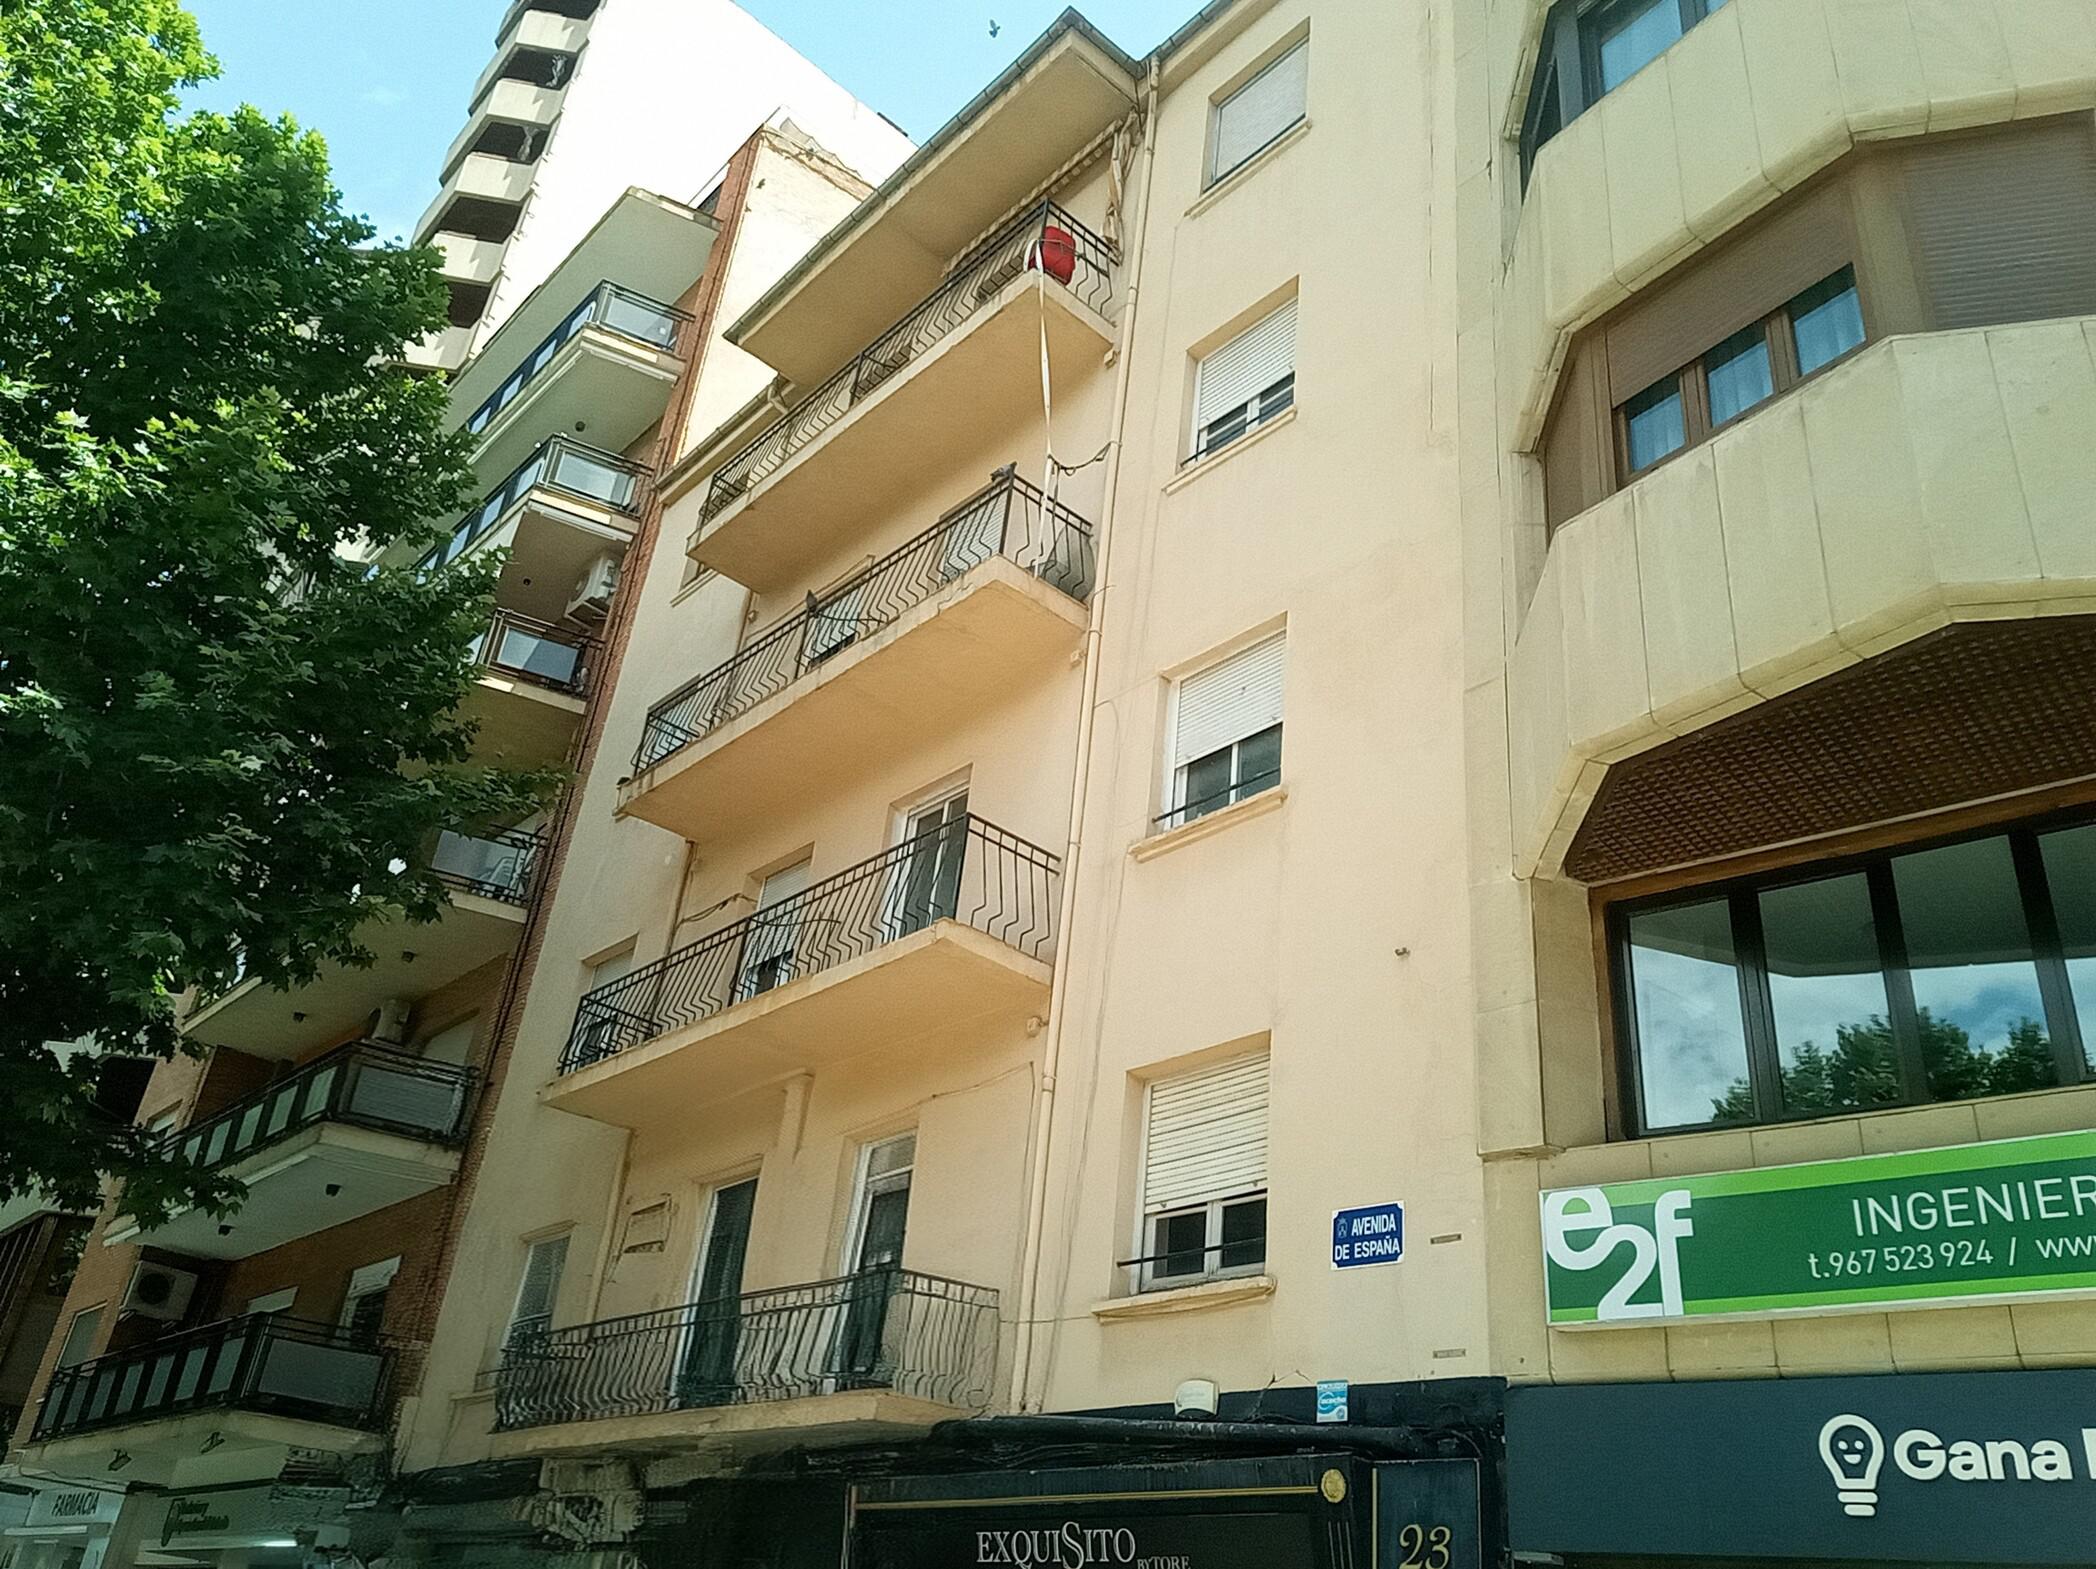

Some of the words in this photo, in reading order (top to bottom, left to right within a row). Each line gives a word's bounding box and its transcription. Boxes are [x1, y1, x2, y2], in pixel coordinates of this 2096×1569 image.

[1351, 1213, 1397, 1237] AVENIDA
[1853, 1175, 2096, 1236] INGENIER
[1334, 1244, 1350, 1261] DE
[1354, 1235, 1400, 1259] ESPAÑA
[1544, 1187, 1694, 1320] e2f
[1883, 1244, 1935, 1272] 523
[1939, 1238, 1994, 1267] 924
[2035, 1234, 2096, 1259] ww
[1893, 1428, 2074, 1481] Gana
[51, 1491, 100, 1517] FARMACIA
[975, 1520, 1137, 1569] EXQUISITO
[1398, 1523, 1452, 1569] 23
